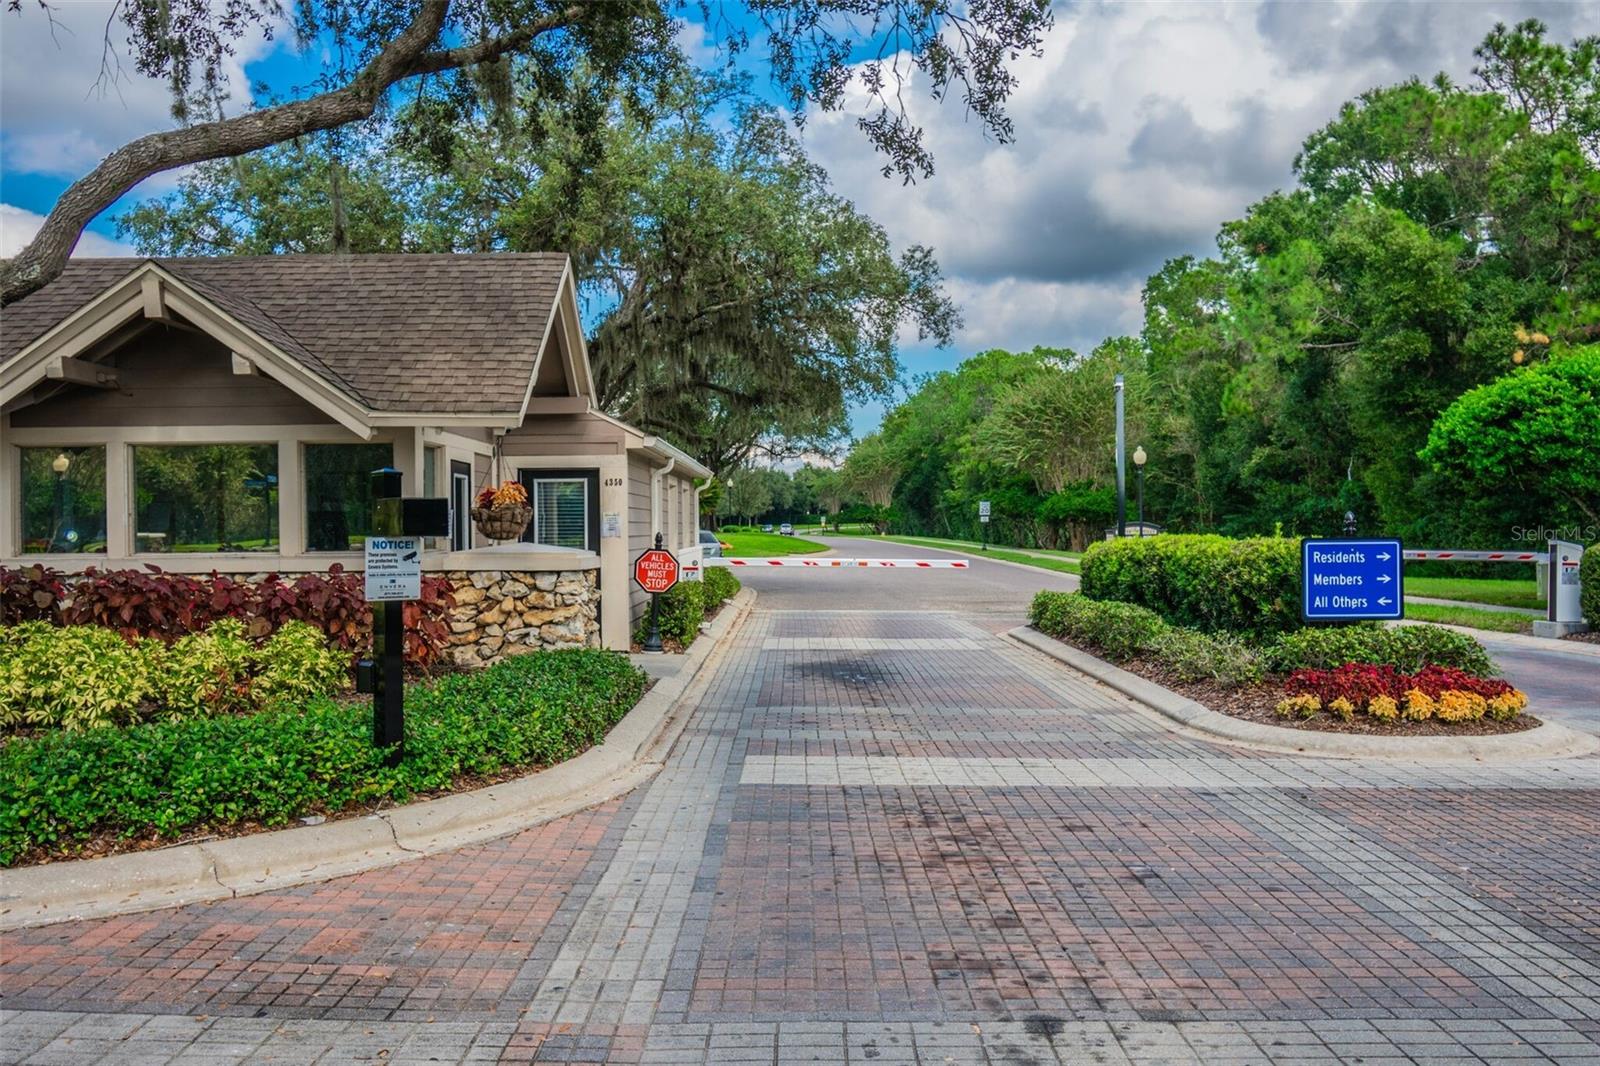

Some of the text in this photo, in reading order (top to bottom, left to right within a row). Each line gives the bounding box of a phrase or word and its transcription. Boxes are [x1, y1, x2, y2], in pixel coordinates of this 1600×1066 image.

[604, 478, 622, 486] 4350
[372, 540, 414, 550] NOTICE!
[650, 554, 664, 562] ALL
[1313, 551, 1366, 564] Residents
[640, 561, 674, 570] VEHICLES
[647, 570, 667, 578] MUST
[645, 578, 668, 589] STOP
[1313, 573, 1363, 586] Members
[1314, 596, 1368, 608] All Others
